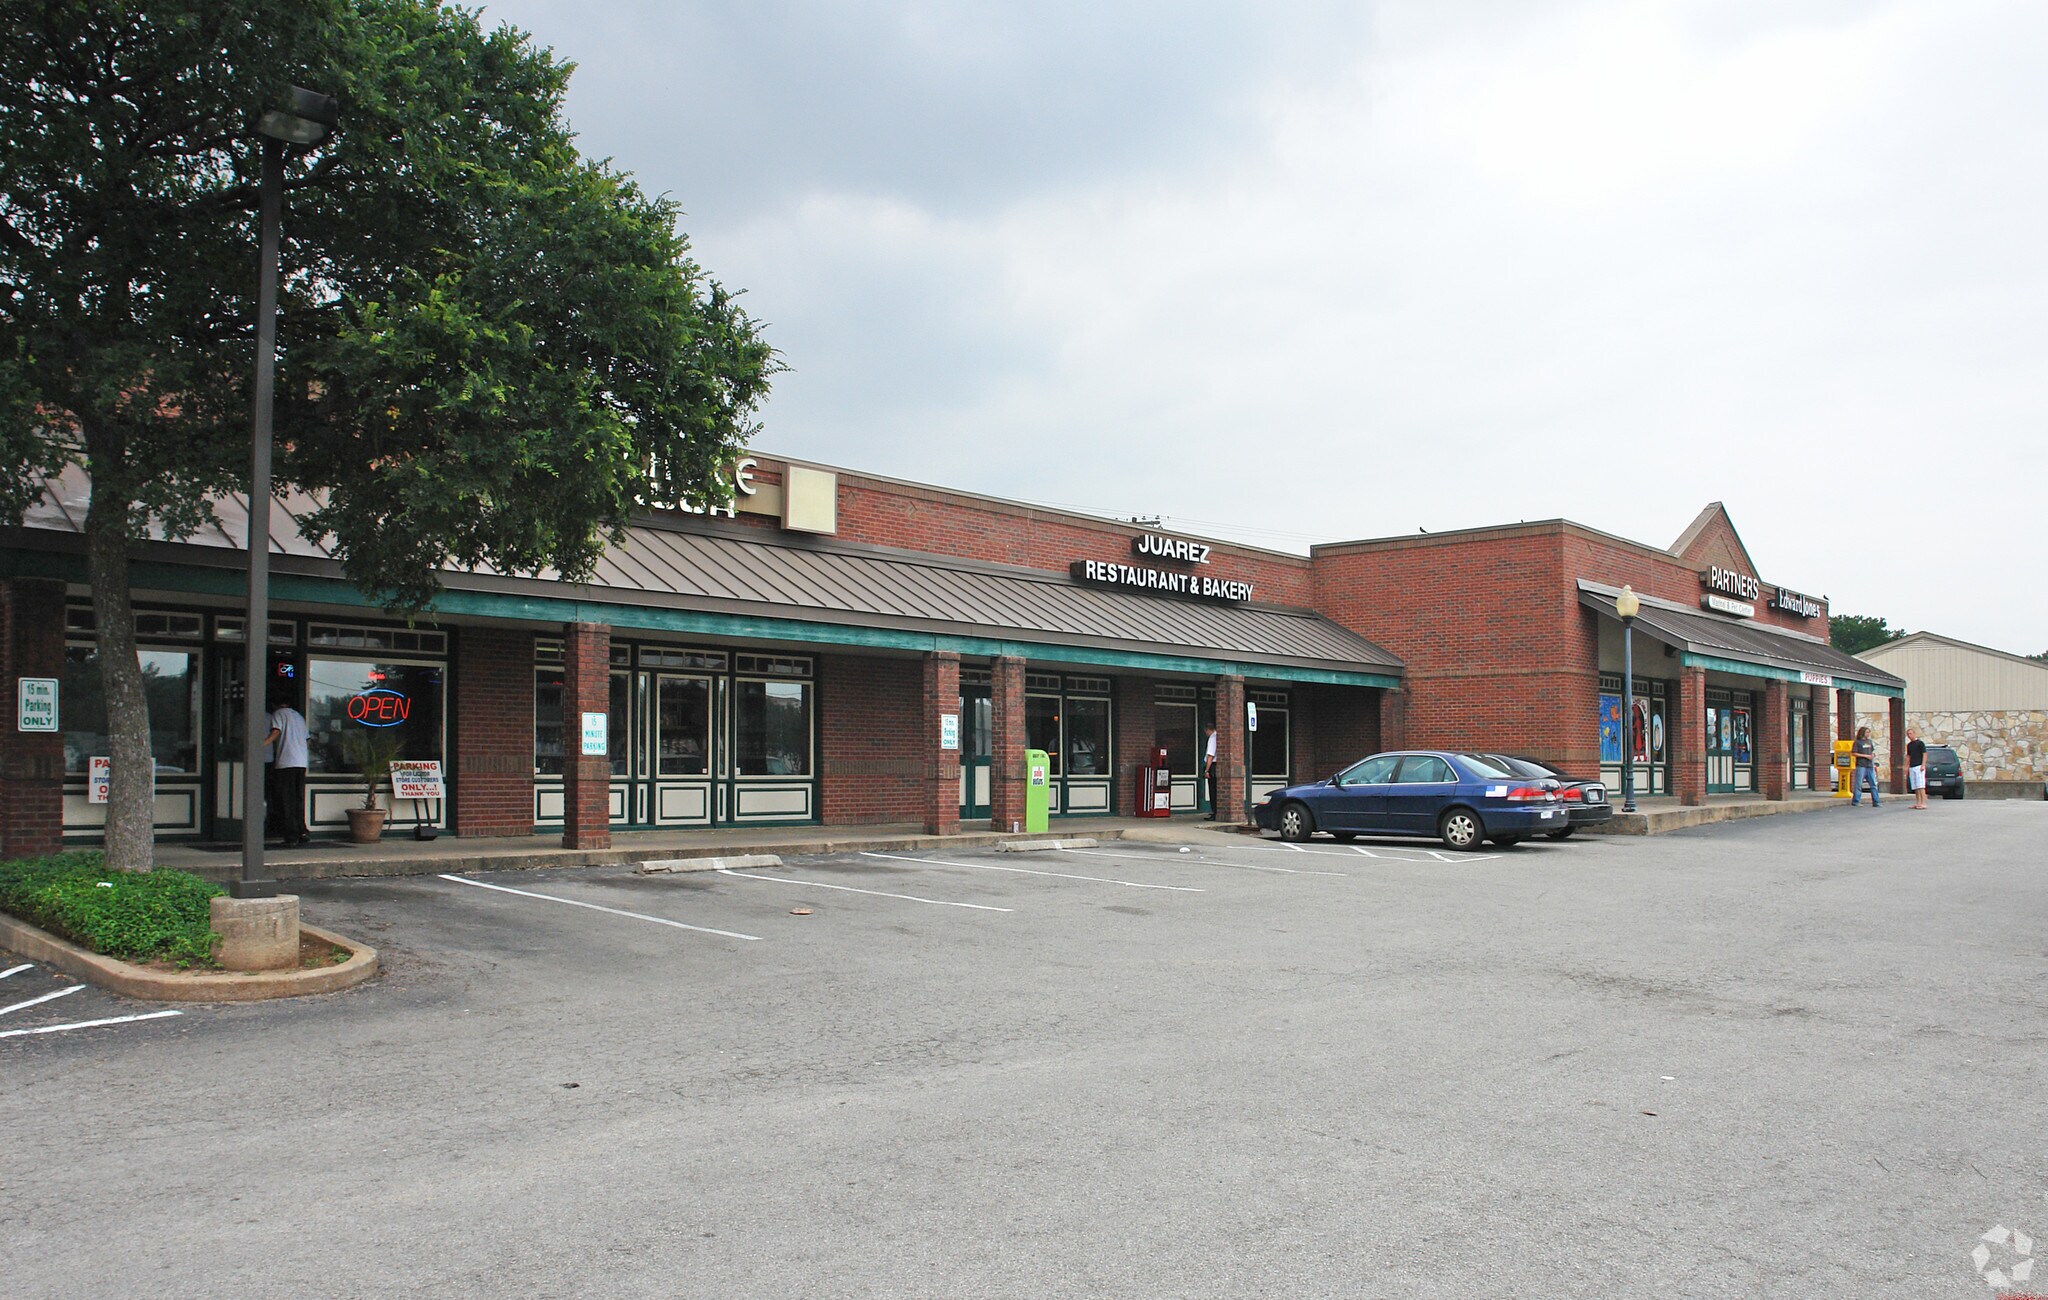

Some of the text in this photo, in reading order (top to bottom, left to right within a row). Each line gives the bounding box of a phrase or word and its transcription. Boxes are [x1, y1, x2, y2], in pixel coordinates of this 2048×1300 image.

[1138, 534, 1210, 564] JUAREZ
[1086, 560, 1253, 602] RESTAURANT & BAKERY
[1711, 565, 1759, 600] PARTNERS
[1779, 587, 1820, 618] Edward Jones
[27, 683, 34, 695] 15
[25, 698, 51, 715] Parking
[347, 696, 411, 719] OPEN
[23, 717, 52, 725] ONLY
[585, 730, 603, 738] MINUTE
[583, 742, 605, 750] PARKING
[393, 762, 437, 770] PARKING
